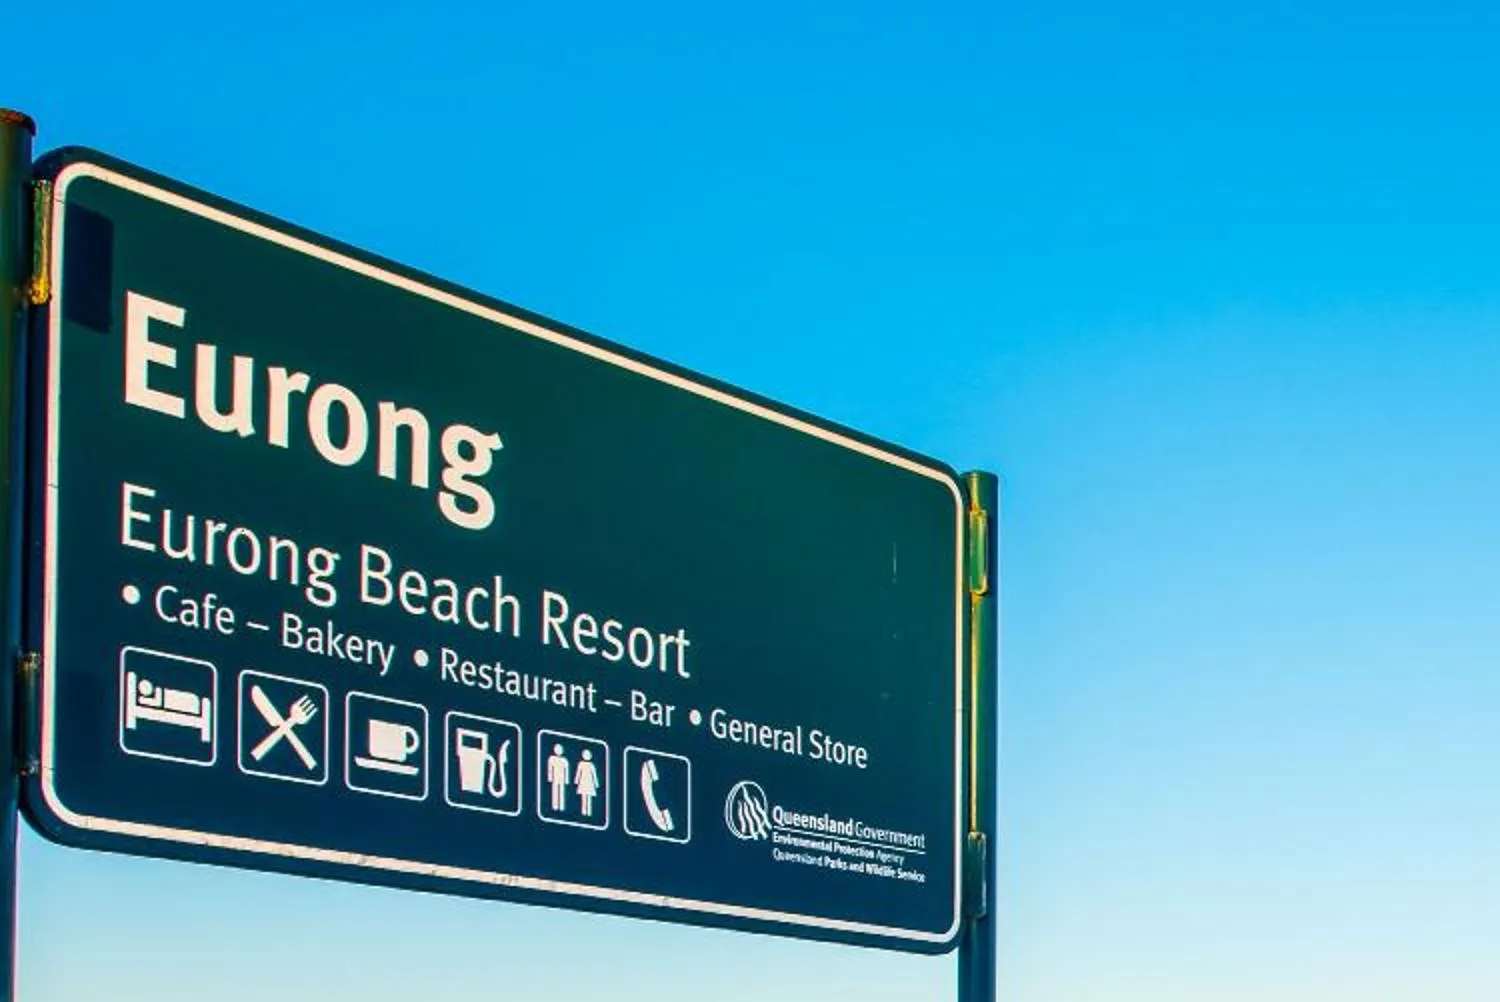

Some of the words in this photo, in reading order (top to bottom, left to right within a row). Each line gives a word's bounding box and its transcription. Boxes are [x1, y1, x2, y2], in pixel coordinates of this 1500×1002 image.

[125, 291, 504, 529] Eurong
[122, 482, 340, 606] Eurong
[361, 544, 521, 637] Beach
[543, 591, 691, 678] Resort
[156, 586, 236, 635] Cafe
[283, 613, 395, 676] Bakery
[442, 648, 597, 713] Restaurant
[632, 690, 676, 727] Bar
[711, 709, 803, 755] General
[810, 729, 868, 769] Store
[772, 806, 854, 836] Queensland
[855, 821, 925, 849] Government
[772, 848, 823, 867] Queensland
[824, 856, 848, 871] Parks
[849, 861, 865, 873] and
[866, 863, 896, 878] Wildlife
[897, 868, 925, 883] Service
[773, 831, 833, 852] Environmental
[834, 841, 875, 859] Protection
[876, 849, 905, 866] Agency
